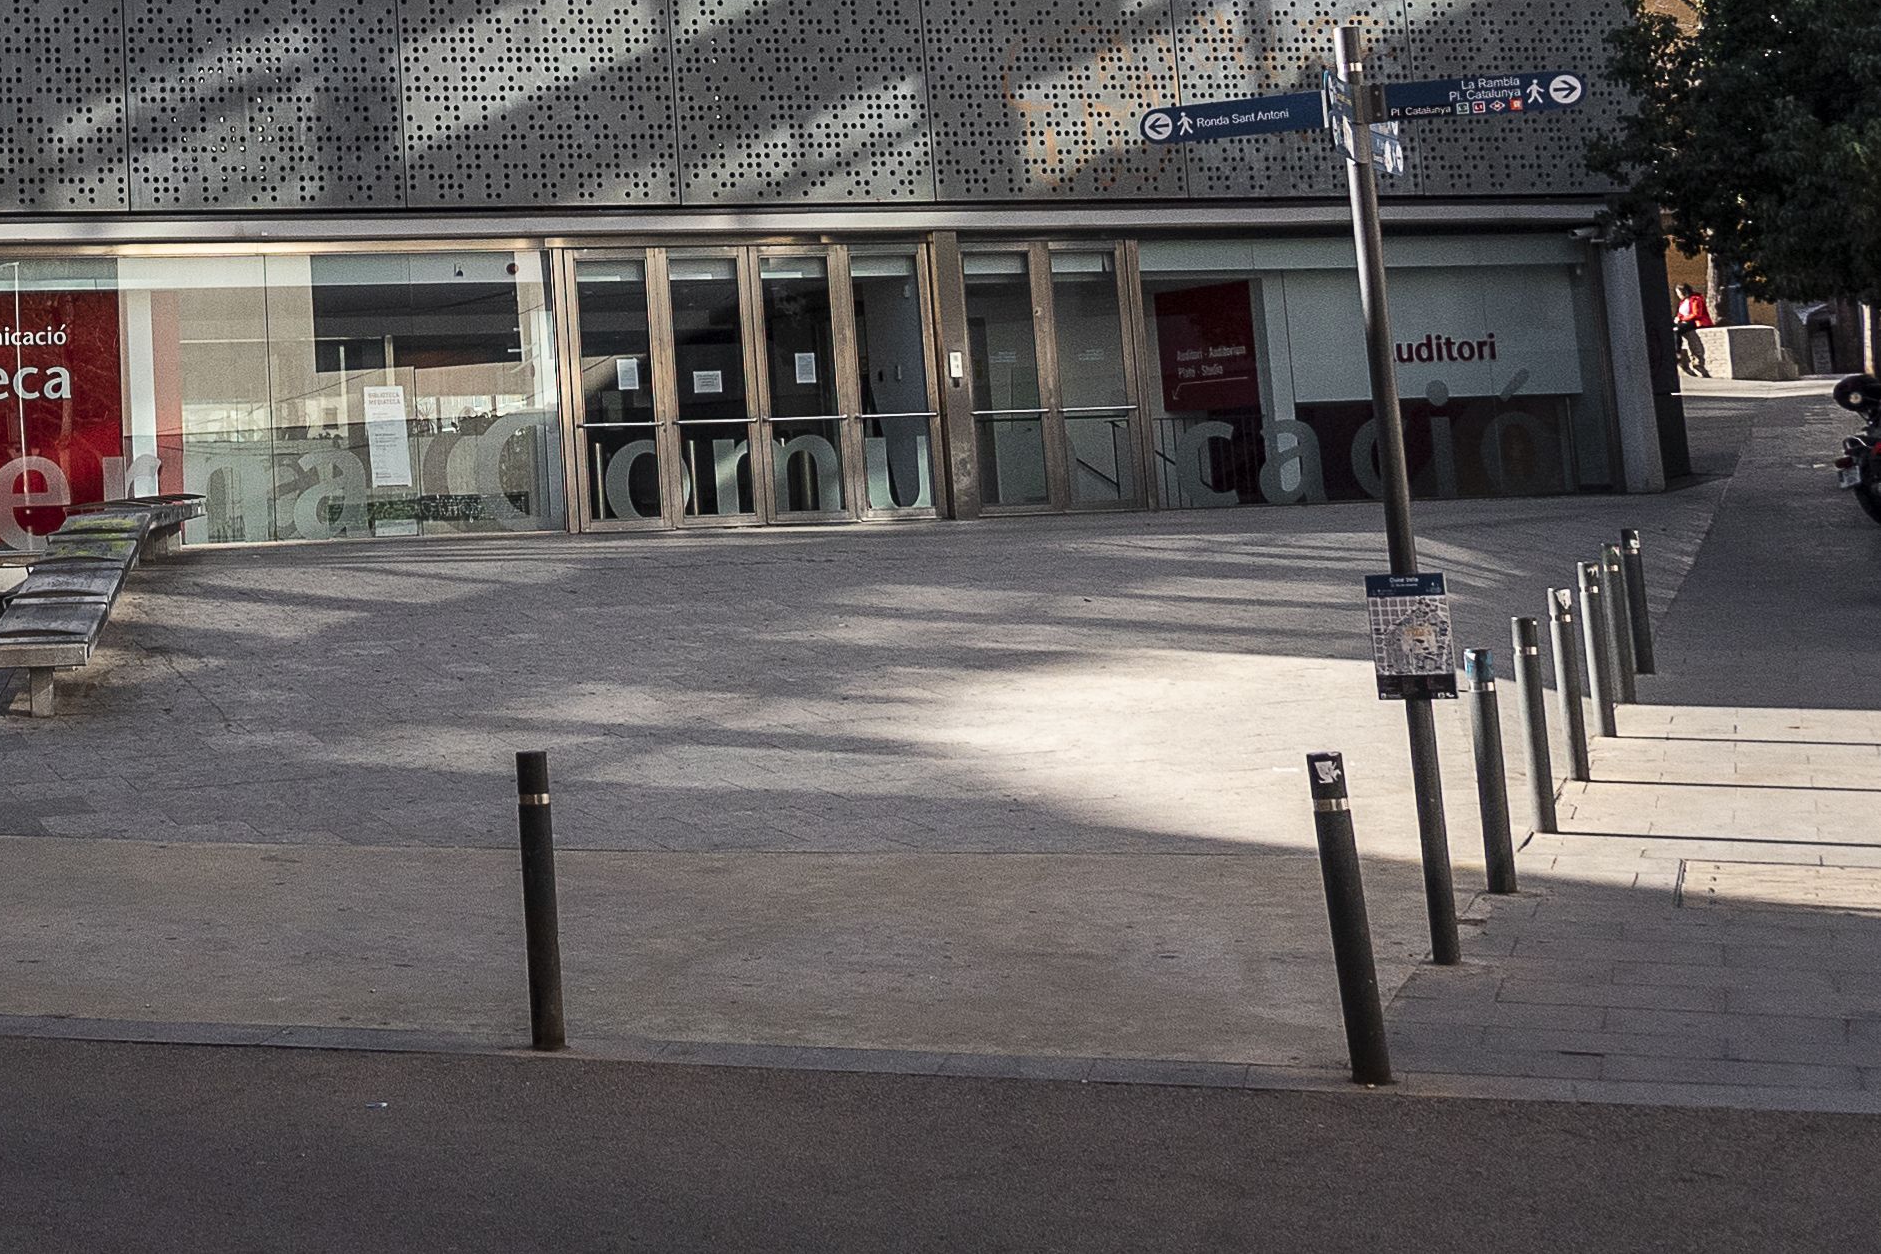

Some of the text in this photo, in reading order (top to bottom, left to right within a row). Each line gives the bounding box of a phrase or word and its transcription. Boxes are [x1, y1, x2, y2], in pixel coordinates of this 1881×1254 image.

[1461, 76, 1521, 90] La Rambla
[1466, 88, 1522, 100] Catalunya
[1196, 108, 1290, 128] Ronda Sant Antoni
[1394, 332, 1497, 363] uditori
